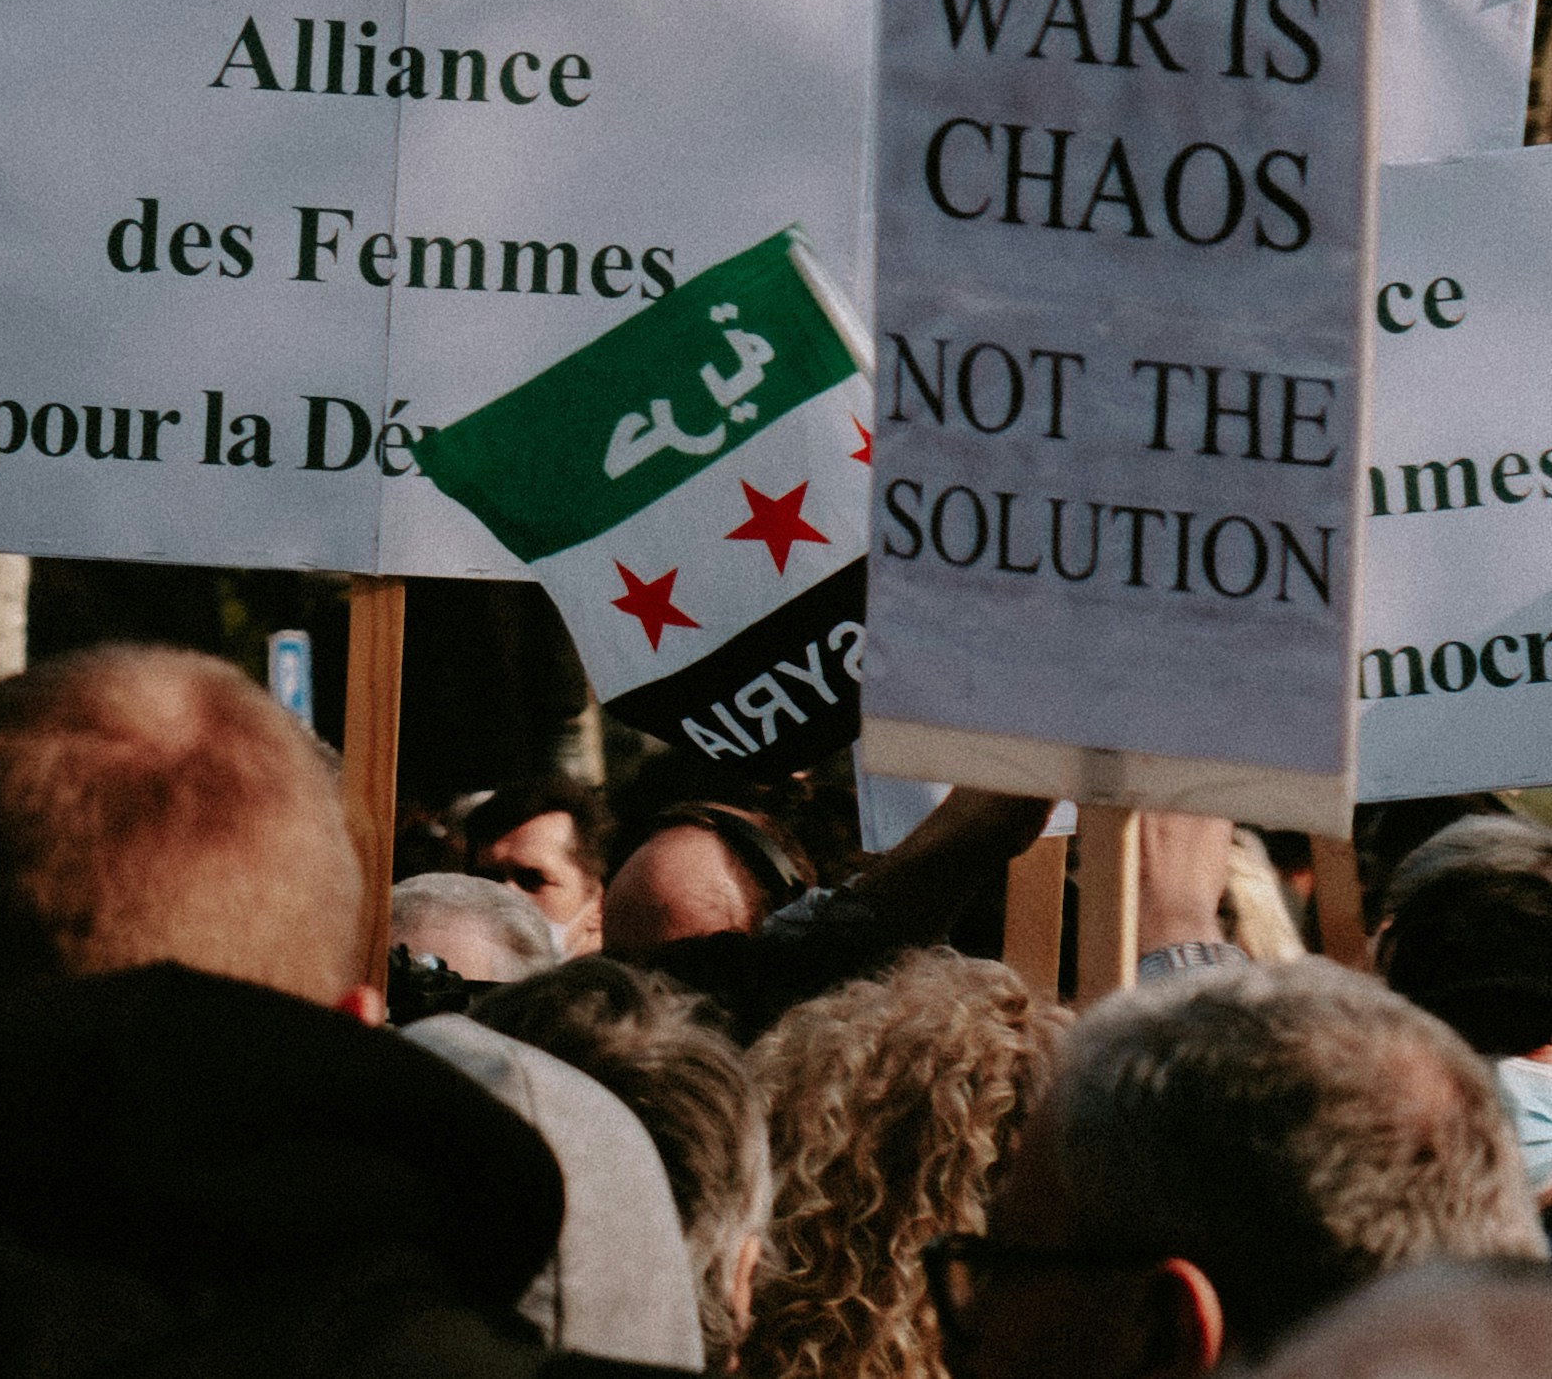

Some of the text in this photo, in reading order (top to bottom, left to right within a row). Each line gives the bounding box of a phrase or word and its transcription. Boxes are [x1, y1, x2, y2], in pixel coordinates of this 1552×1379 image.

[207, 14, 593, 108] Alliance
[924, 115, 1314, 254] CHAOS
[105, 197, 678, 303] des Femmes
[1375, 276, 1468, 335] ce
[201, 391, 274, 467] la
[298, 395, 440, 478] Dé
[886, 330, 1339, 472] NOT THE
[882, 477, 1337, 607] SOLUTION
